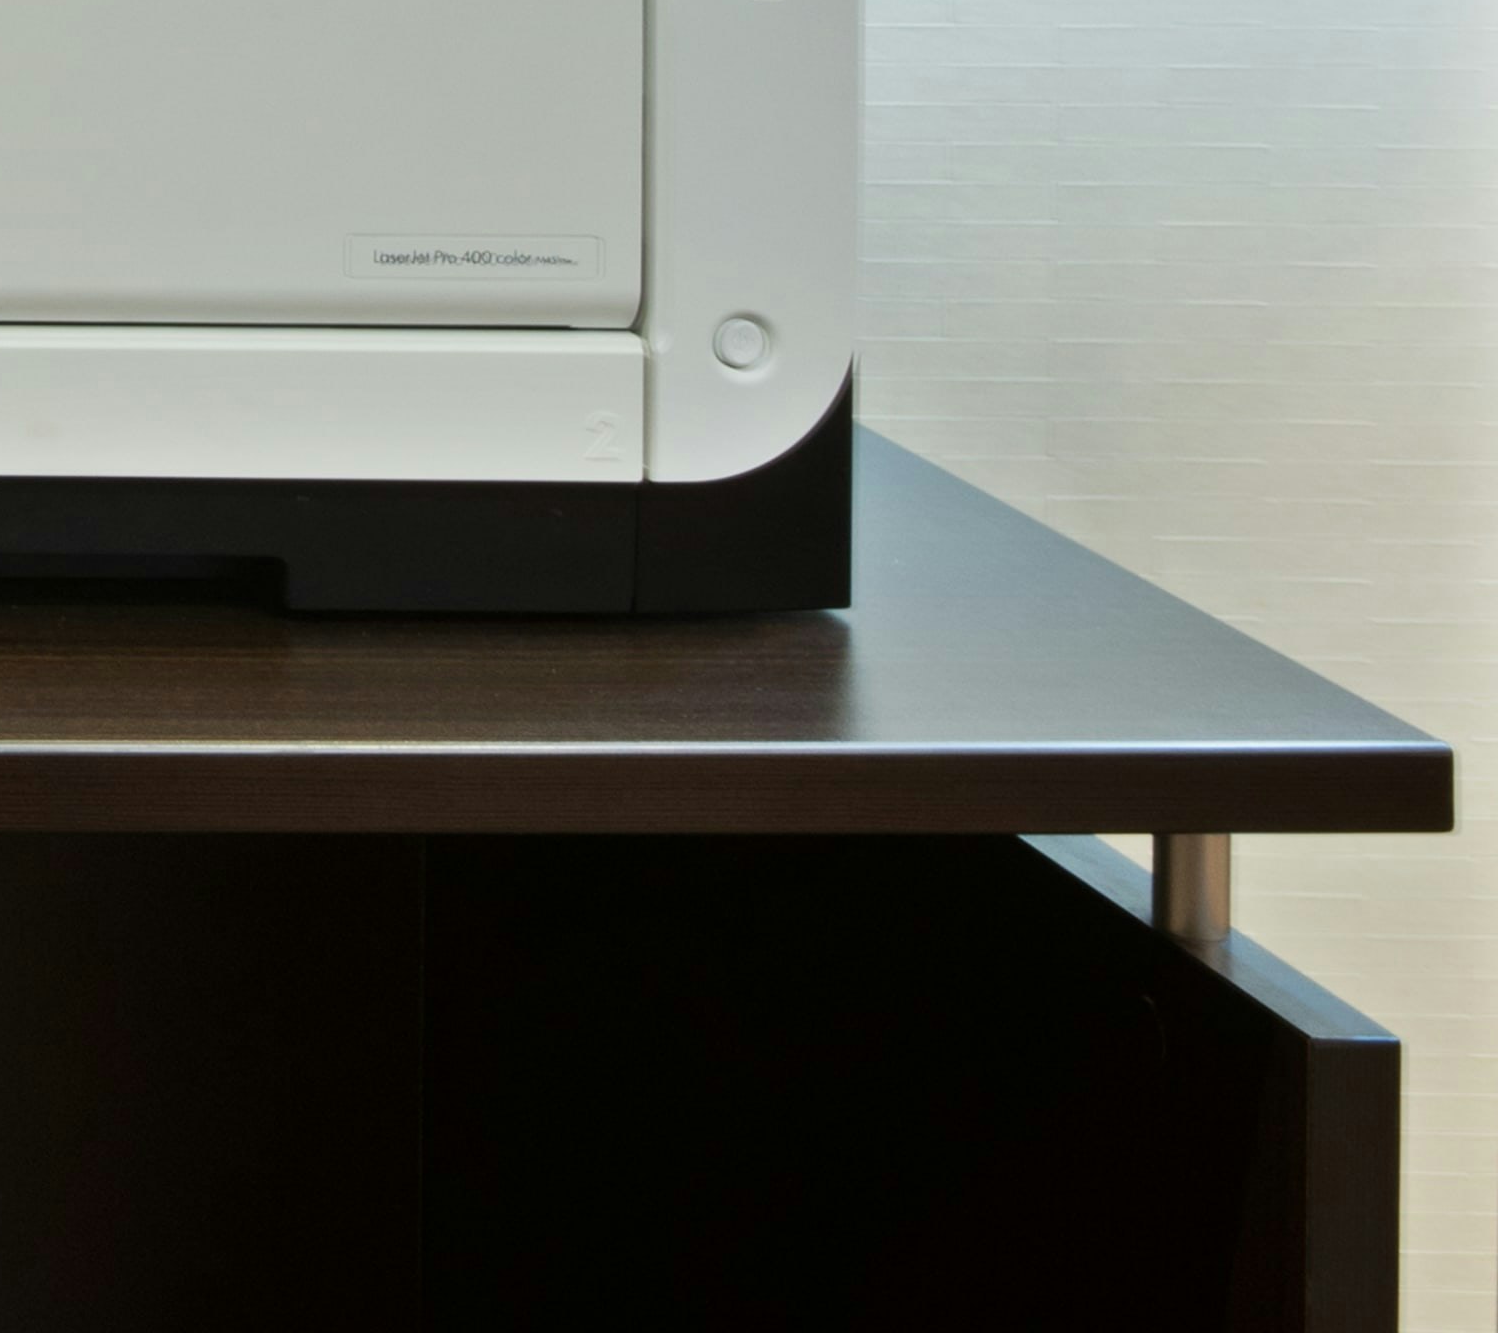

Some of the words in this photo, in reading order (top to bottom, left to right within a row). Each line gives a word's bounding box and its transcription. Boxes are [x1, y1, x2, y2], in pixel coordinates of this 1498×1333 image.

[373, 249, 430, 265] LaserJet
[434, 249, 456, 265] Pro
[461, 250, 492, 265] 400
[496, 250, 532, 265] color
